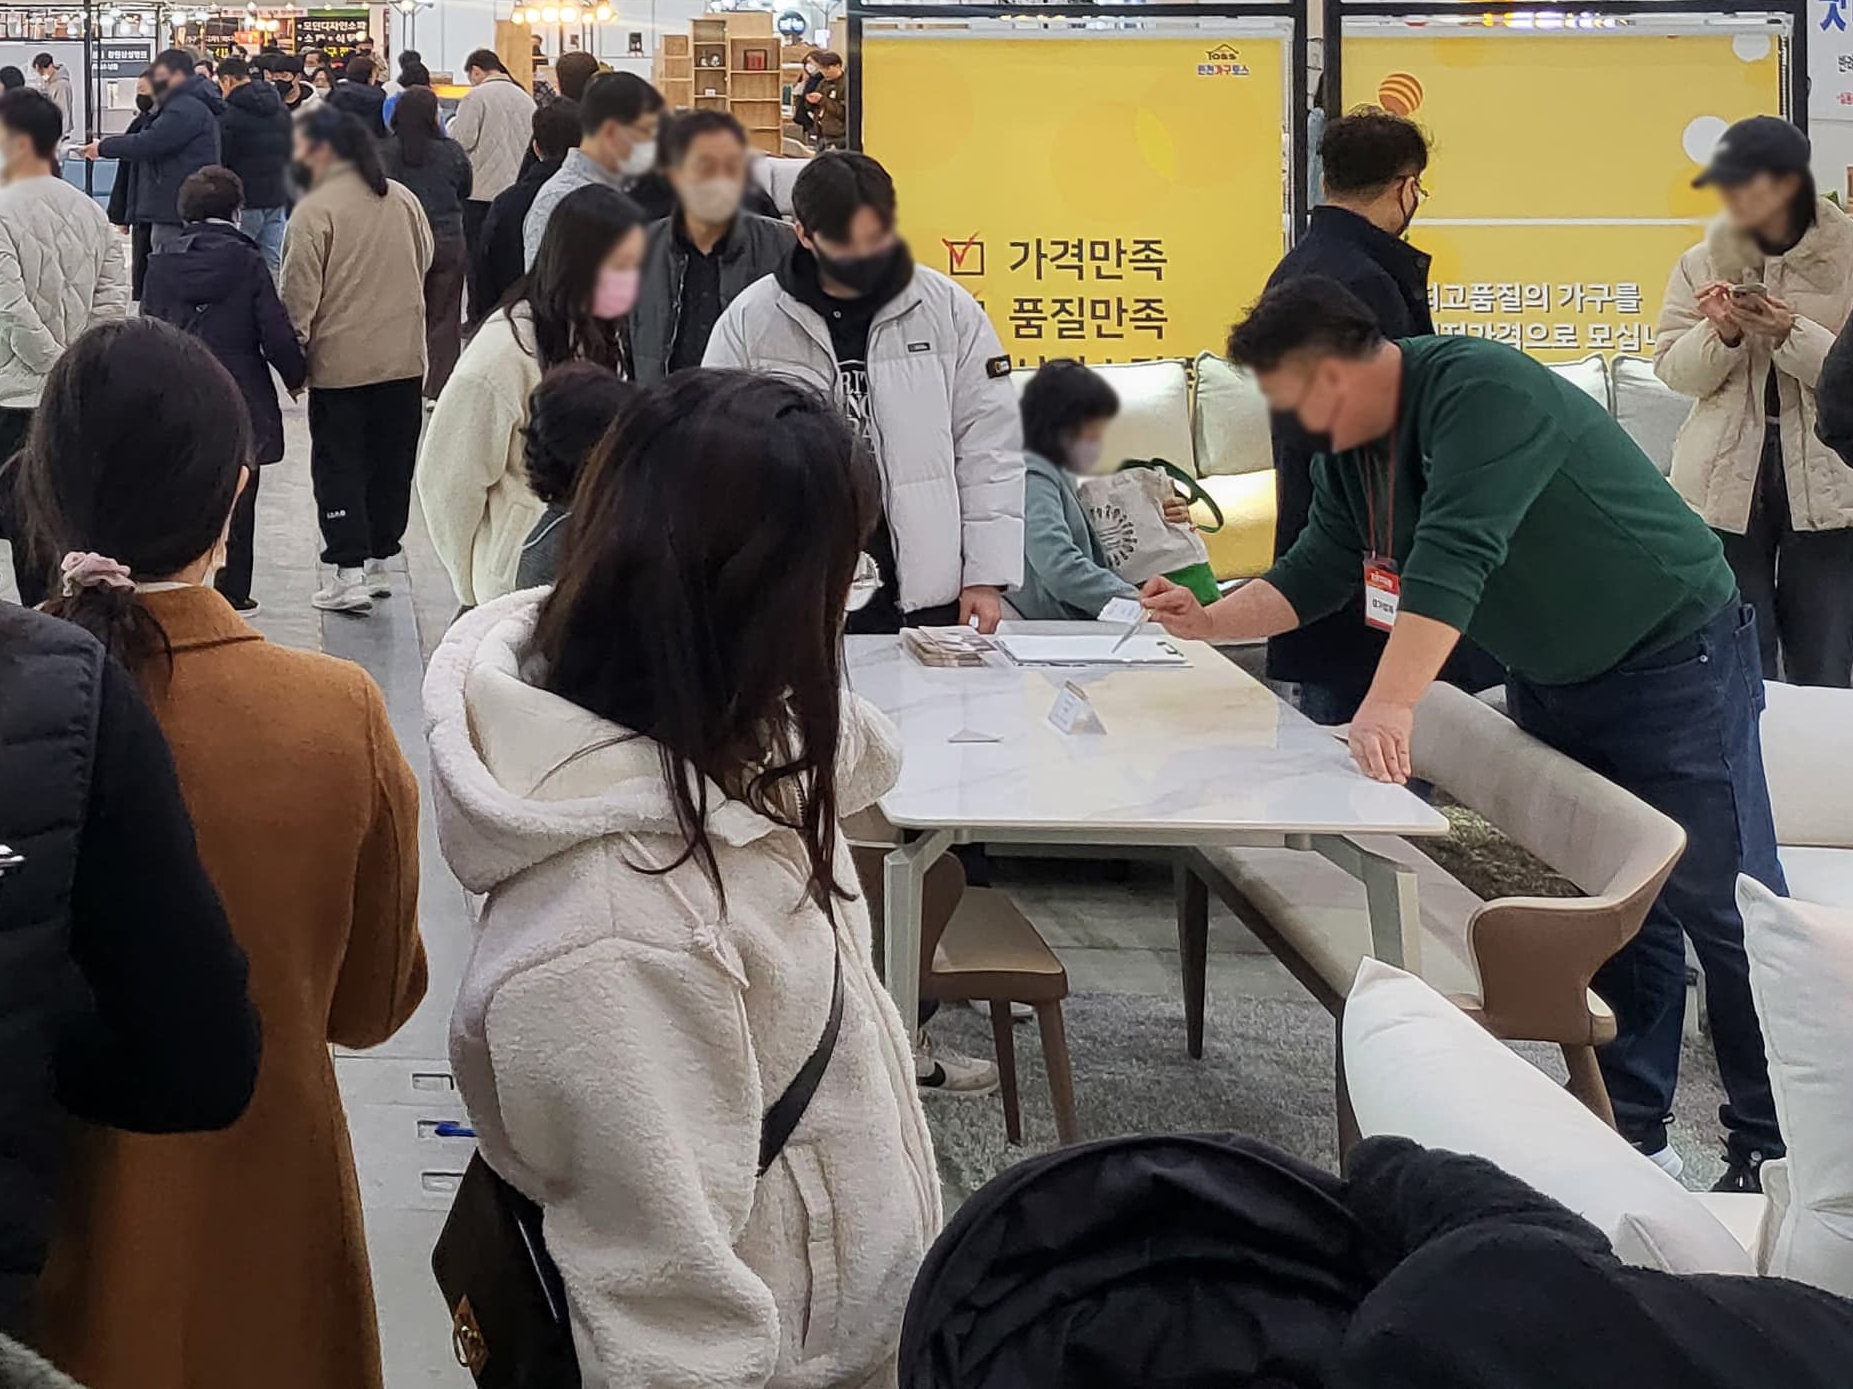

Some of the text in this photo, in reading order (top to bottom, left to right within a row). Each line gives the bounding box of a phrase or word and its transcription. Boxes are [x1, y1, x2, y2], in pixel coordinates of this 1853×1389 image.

[1009, 238, 1168, 281] 가격만족
[1009, 296, 1168, 340] 품질만족
[1558, 281, 1643, 313] 가구를
